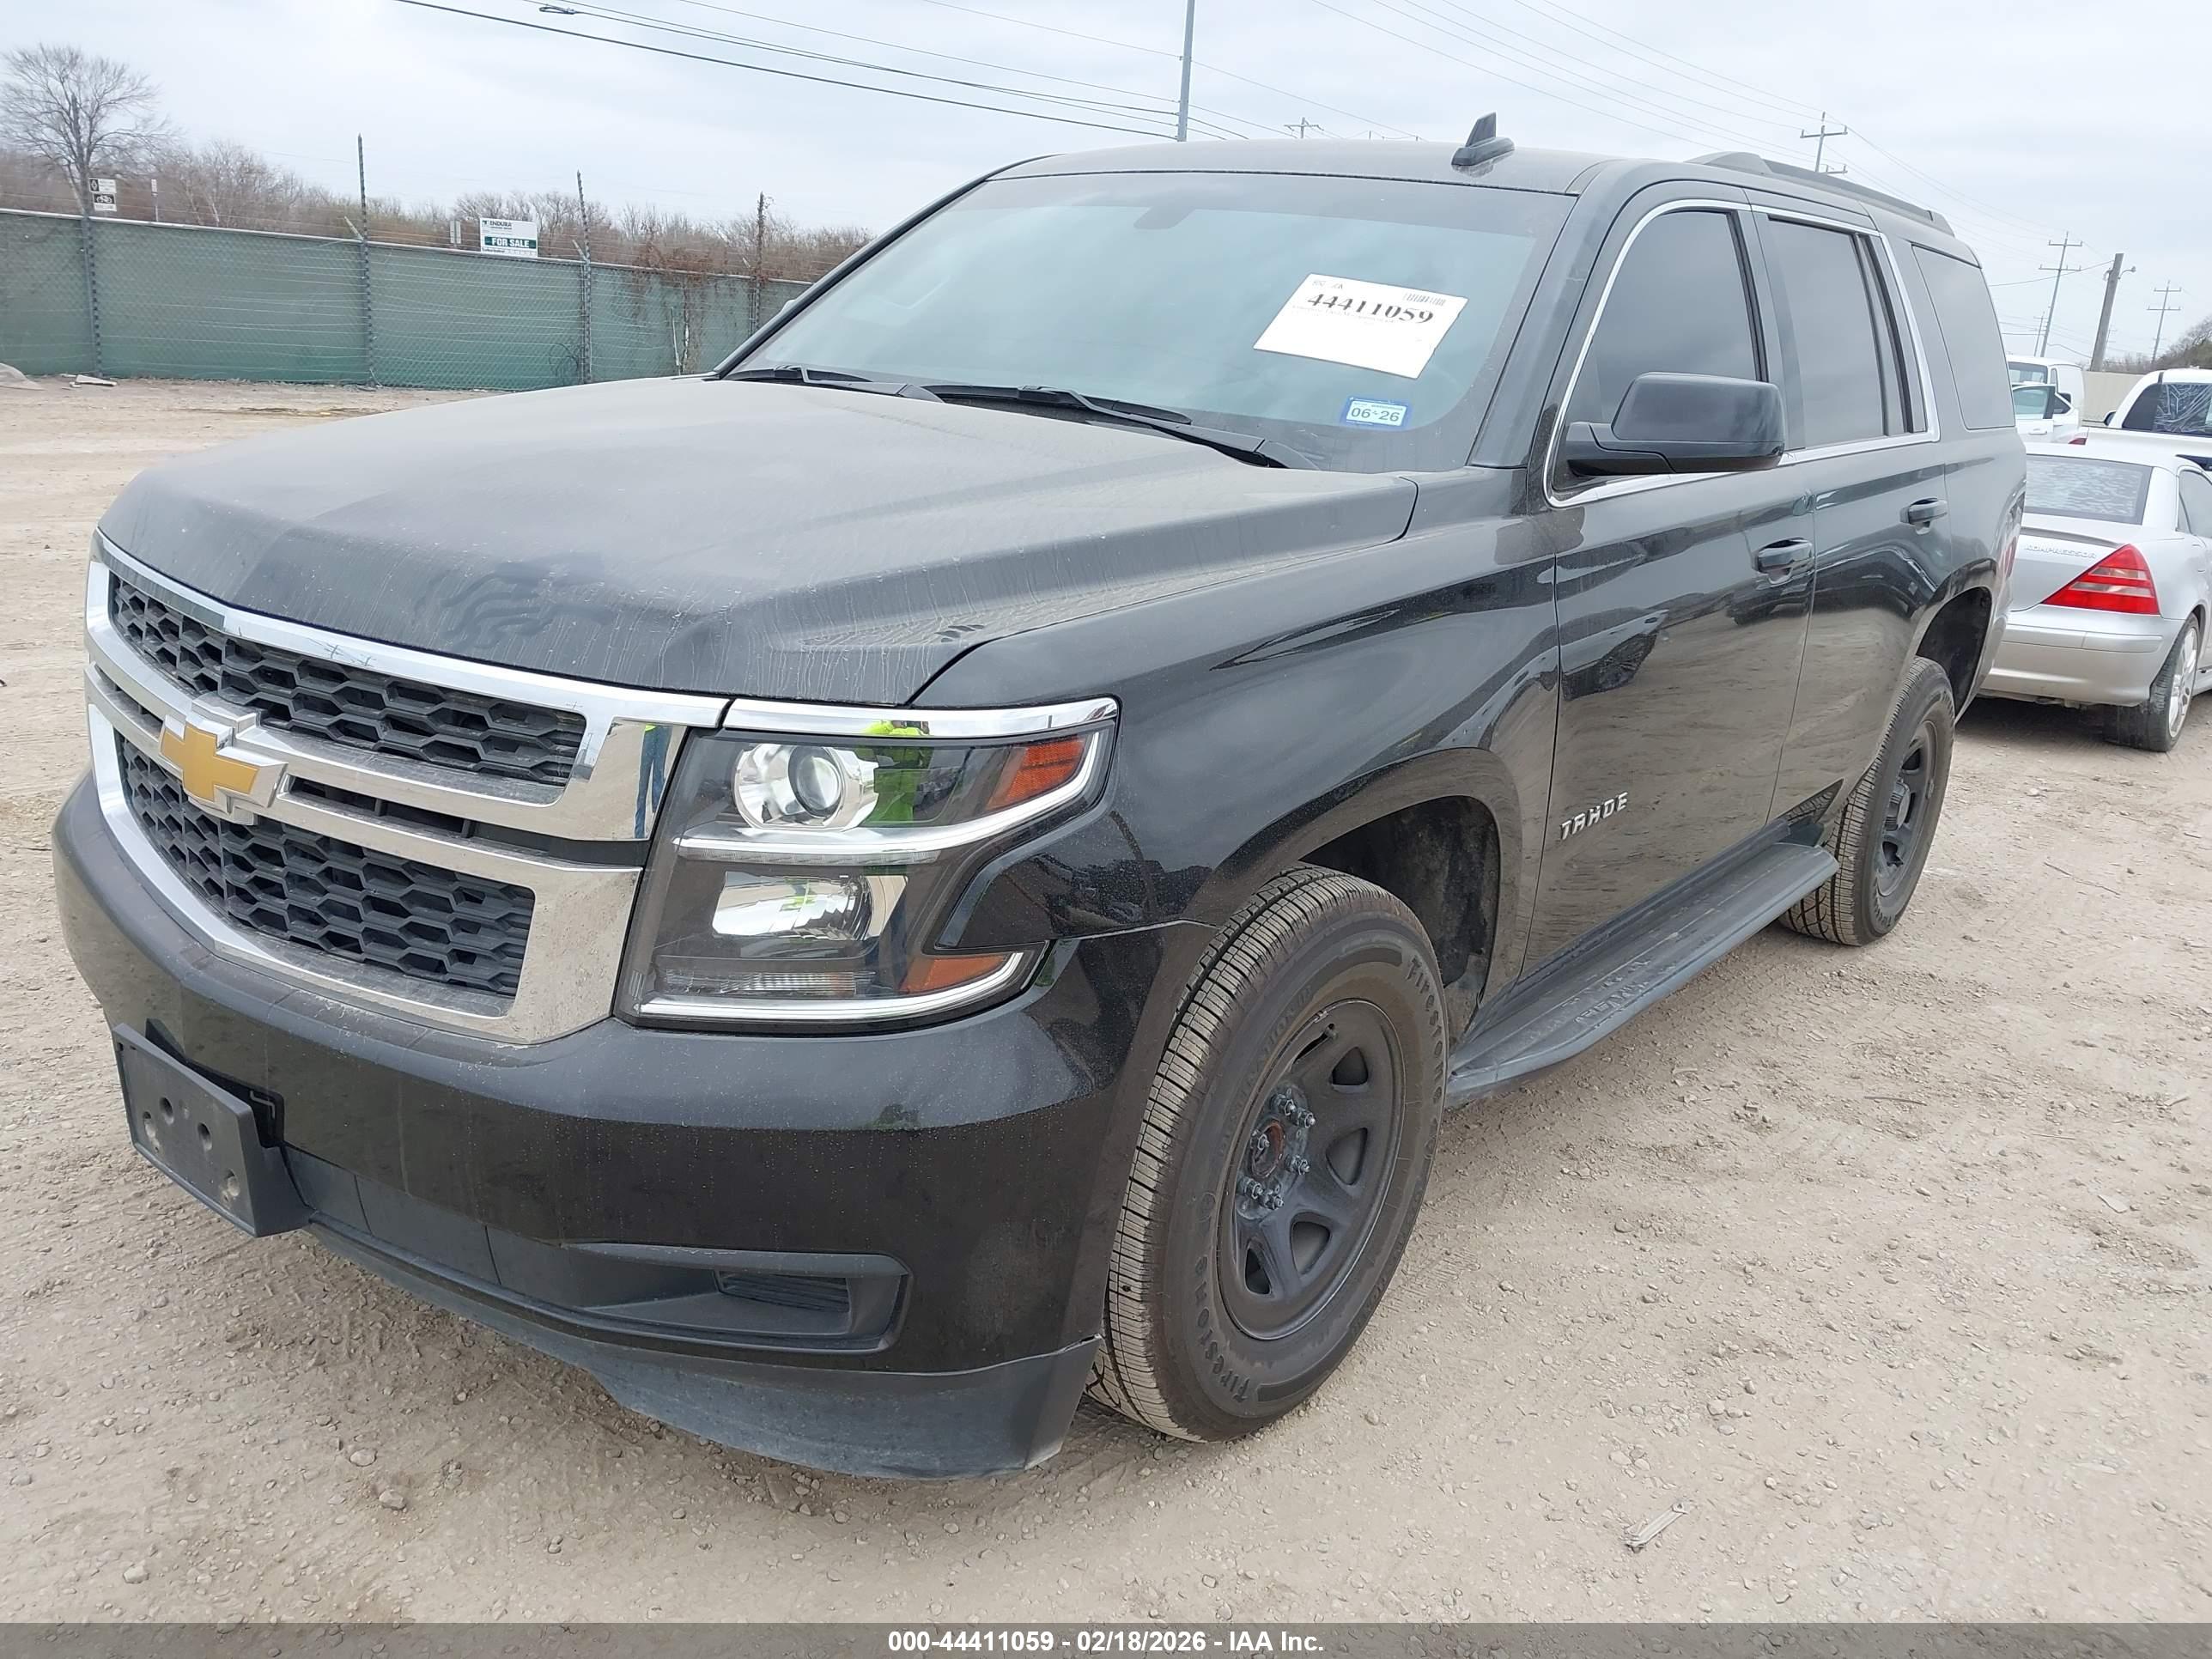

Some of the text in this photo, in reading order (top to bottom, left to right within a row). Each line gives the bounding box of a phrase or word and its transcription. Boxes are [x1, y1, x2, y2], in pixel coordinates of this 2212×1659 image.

[491, 237, 530, 248] FOR SALE
[1307, 293, 1434, 324] 44411059
[1351, 407, 1401, 422] 06 26
[2024, 544, 2097, 559] KOMPRESSOR
[1561, 791, 1629, 841] TAHOE
[1407, 954, 1444, 1105] Firestone
[1194, 1255, 1250, 1404] Firestone
